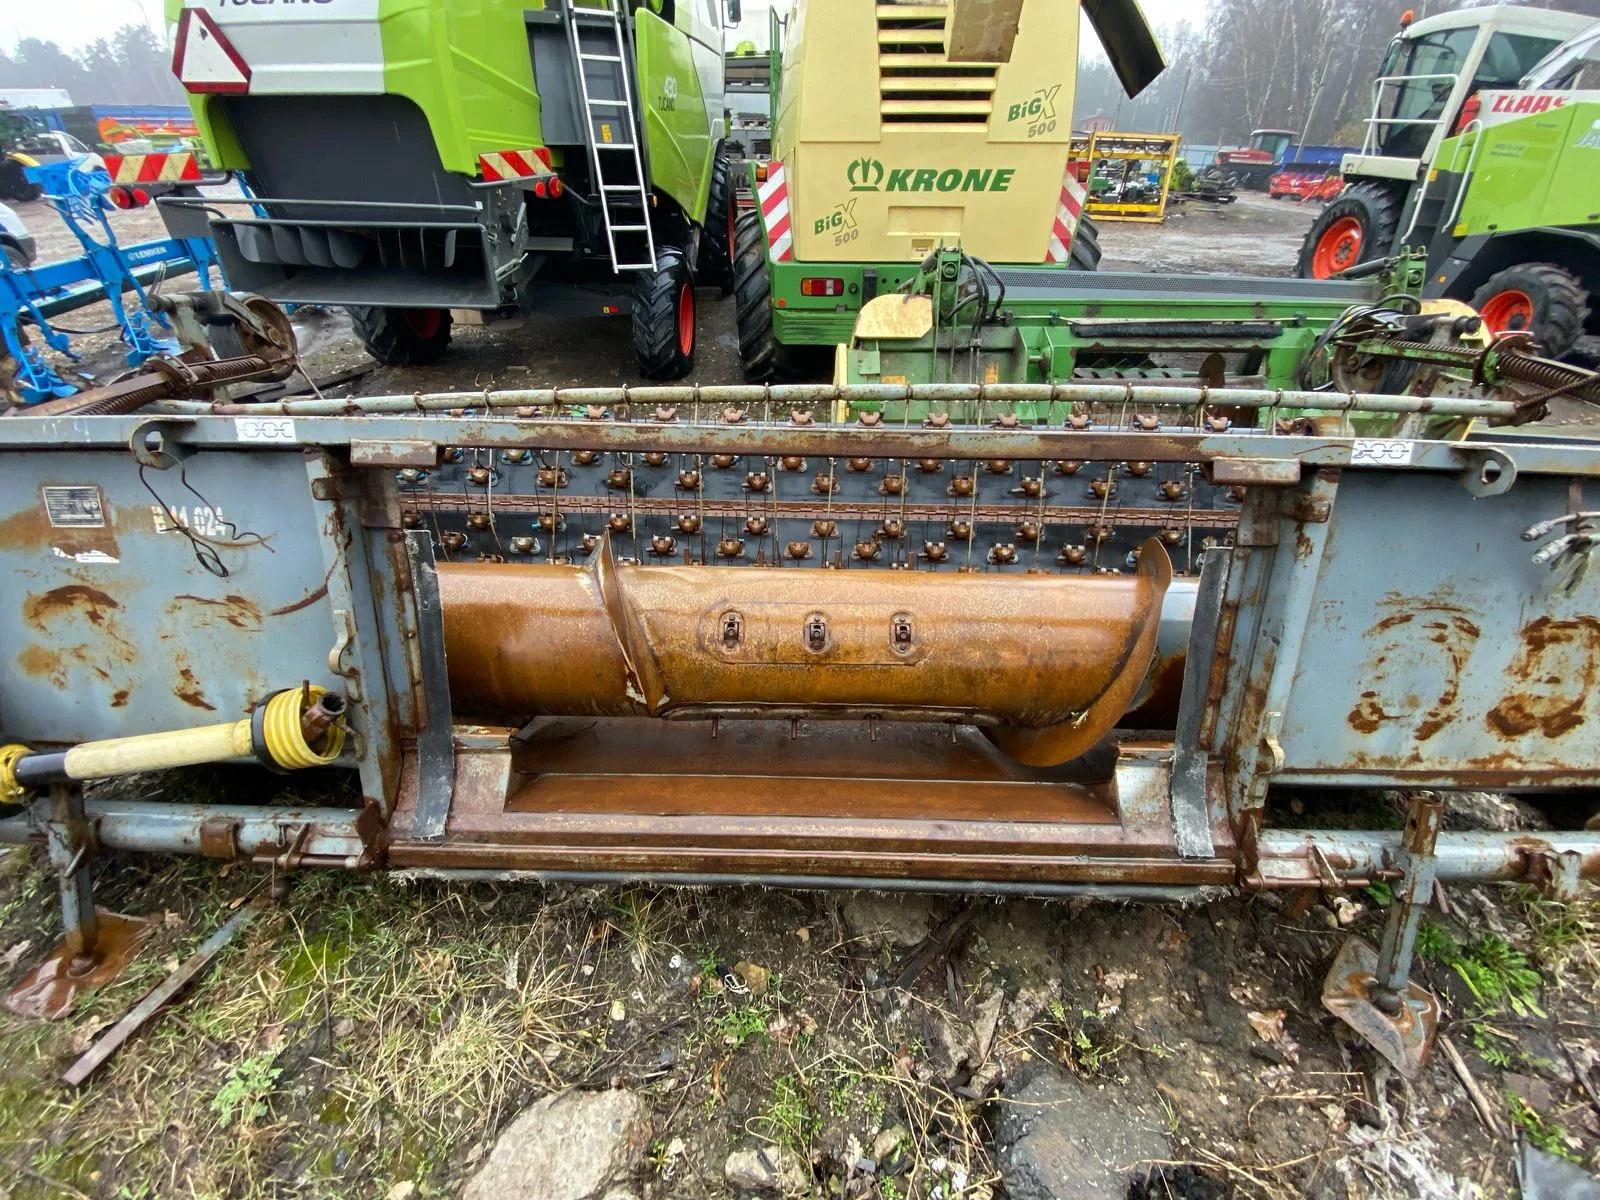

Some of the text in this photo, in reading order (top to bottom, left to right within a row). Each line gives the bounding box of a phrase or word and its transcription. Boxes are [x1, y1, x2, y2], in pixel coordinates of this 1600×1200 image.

[1027, 119, 1057, 138] 500
[885, 168, 1016, 192] KRONE
[834, 229, 859, 247] 500
[193, 506, 226, 536] 024
